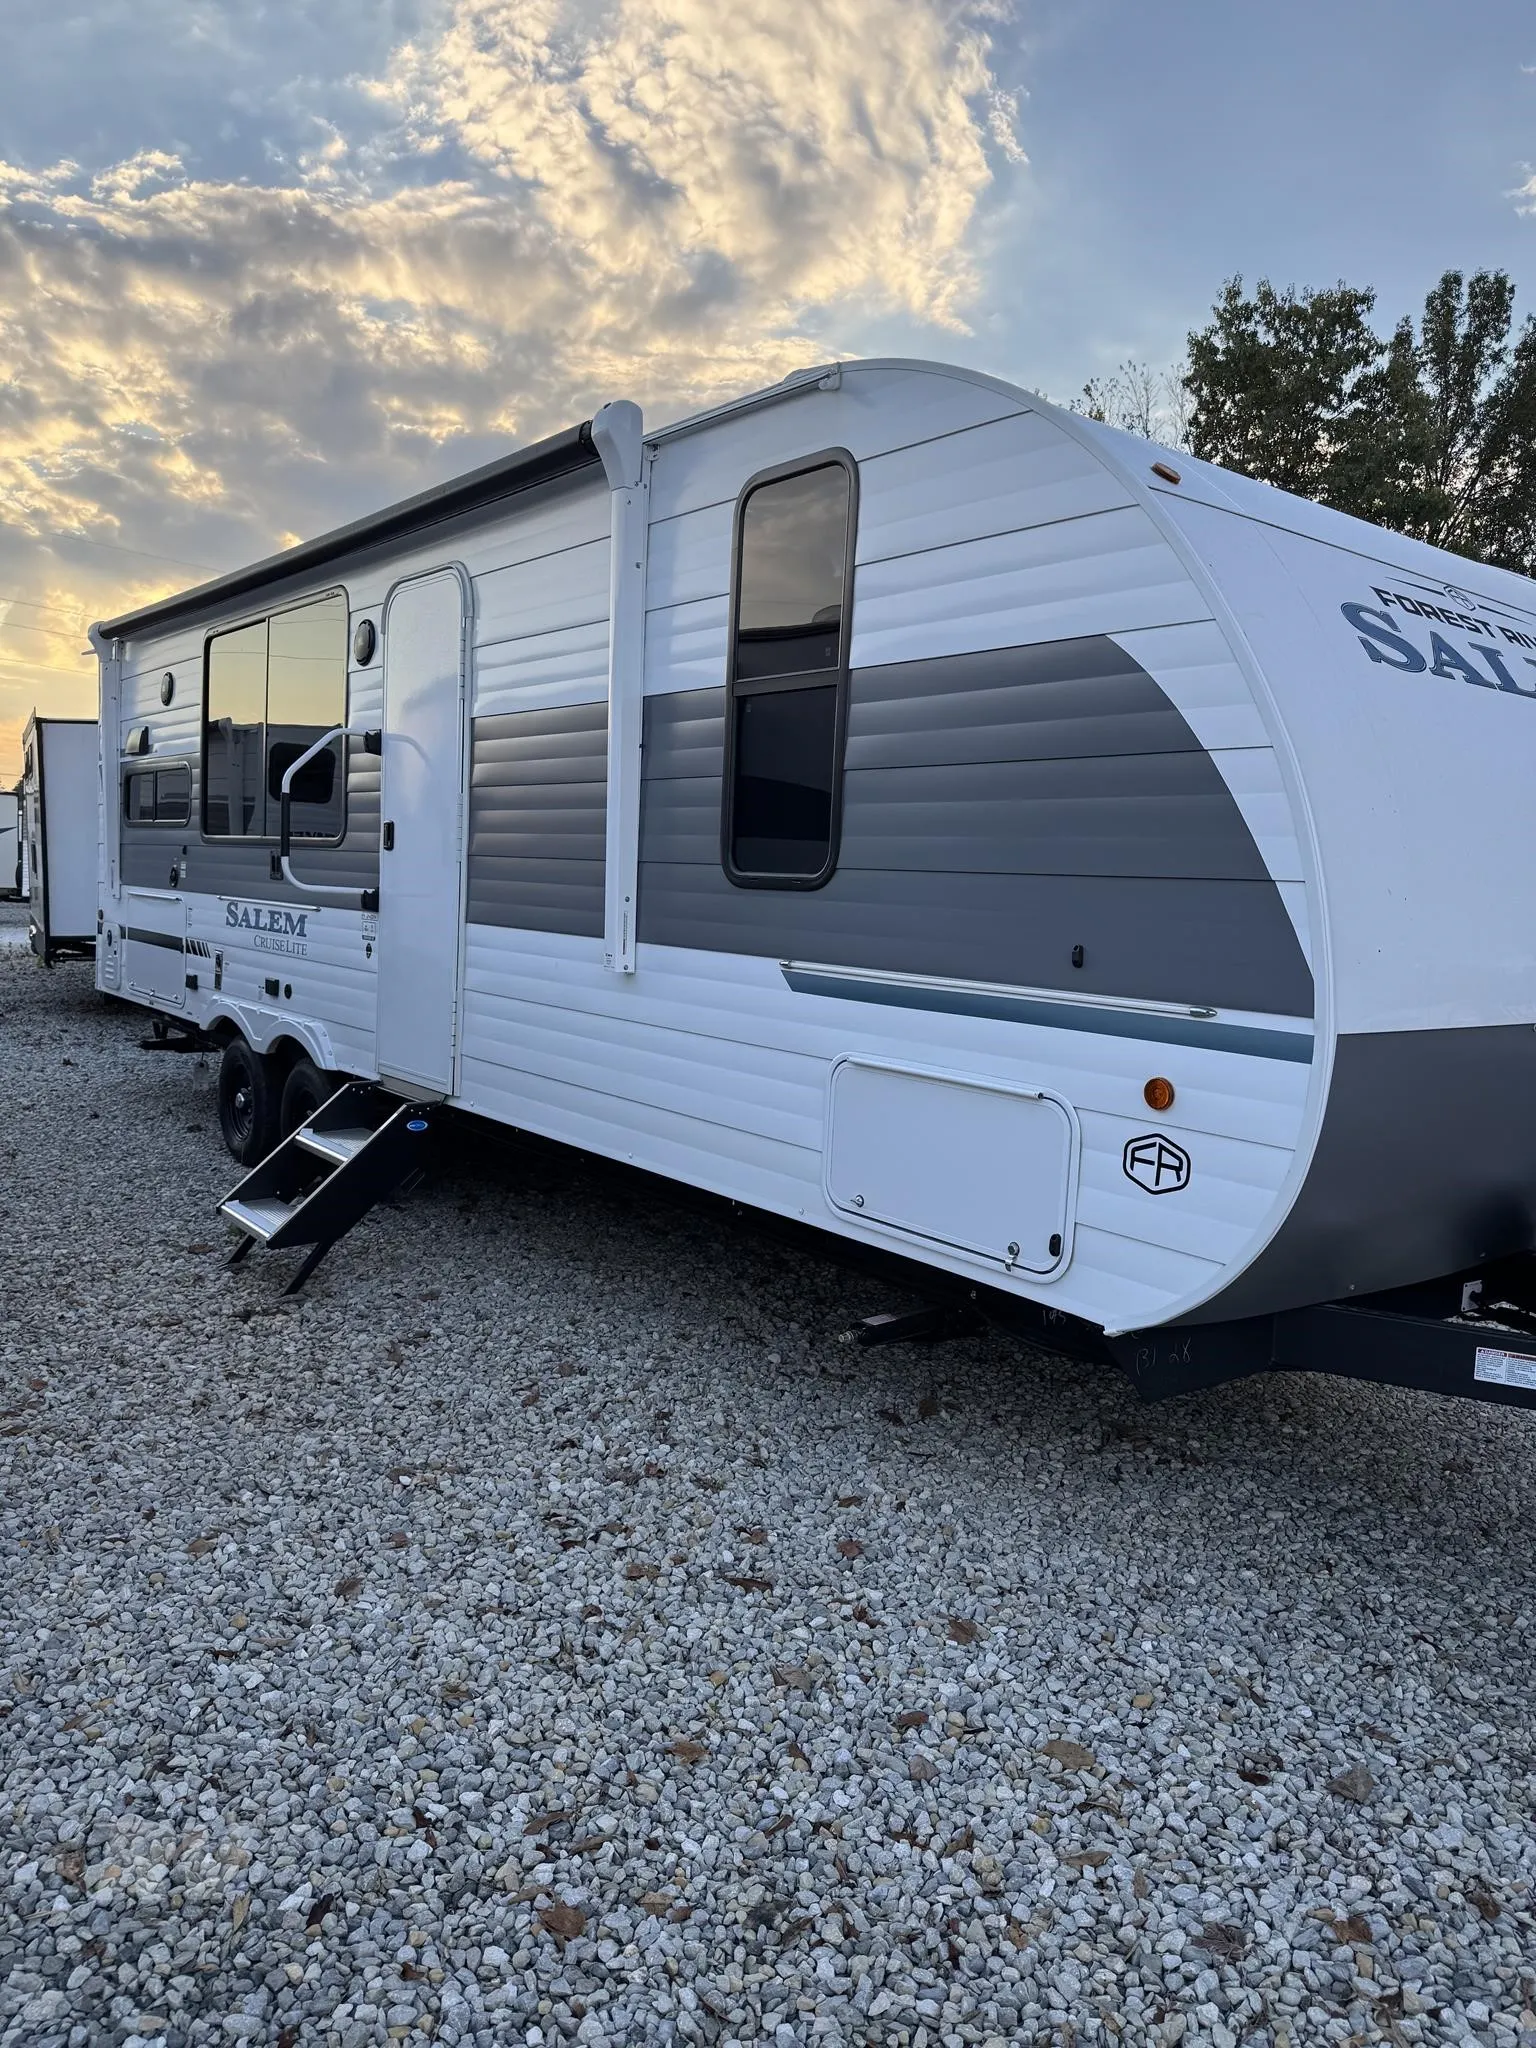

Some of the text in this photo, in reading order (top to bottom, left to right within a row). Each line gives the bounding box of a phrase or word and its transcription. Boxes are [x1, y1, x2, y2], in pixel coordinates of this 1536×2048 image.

[1368, 585, 1497, 638] FOREST
[226, 901, 308, 937] SALEM
[253, 934, 308, 956] CRUISELITE
[1129, 1141, 1184, 1187] FR
